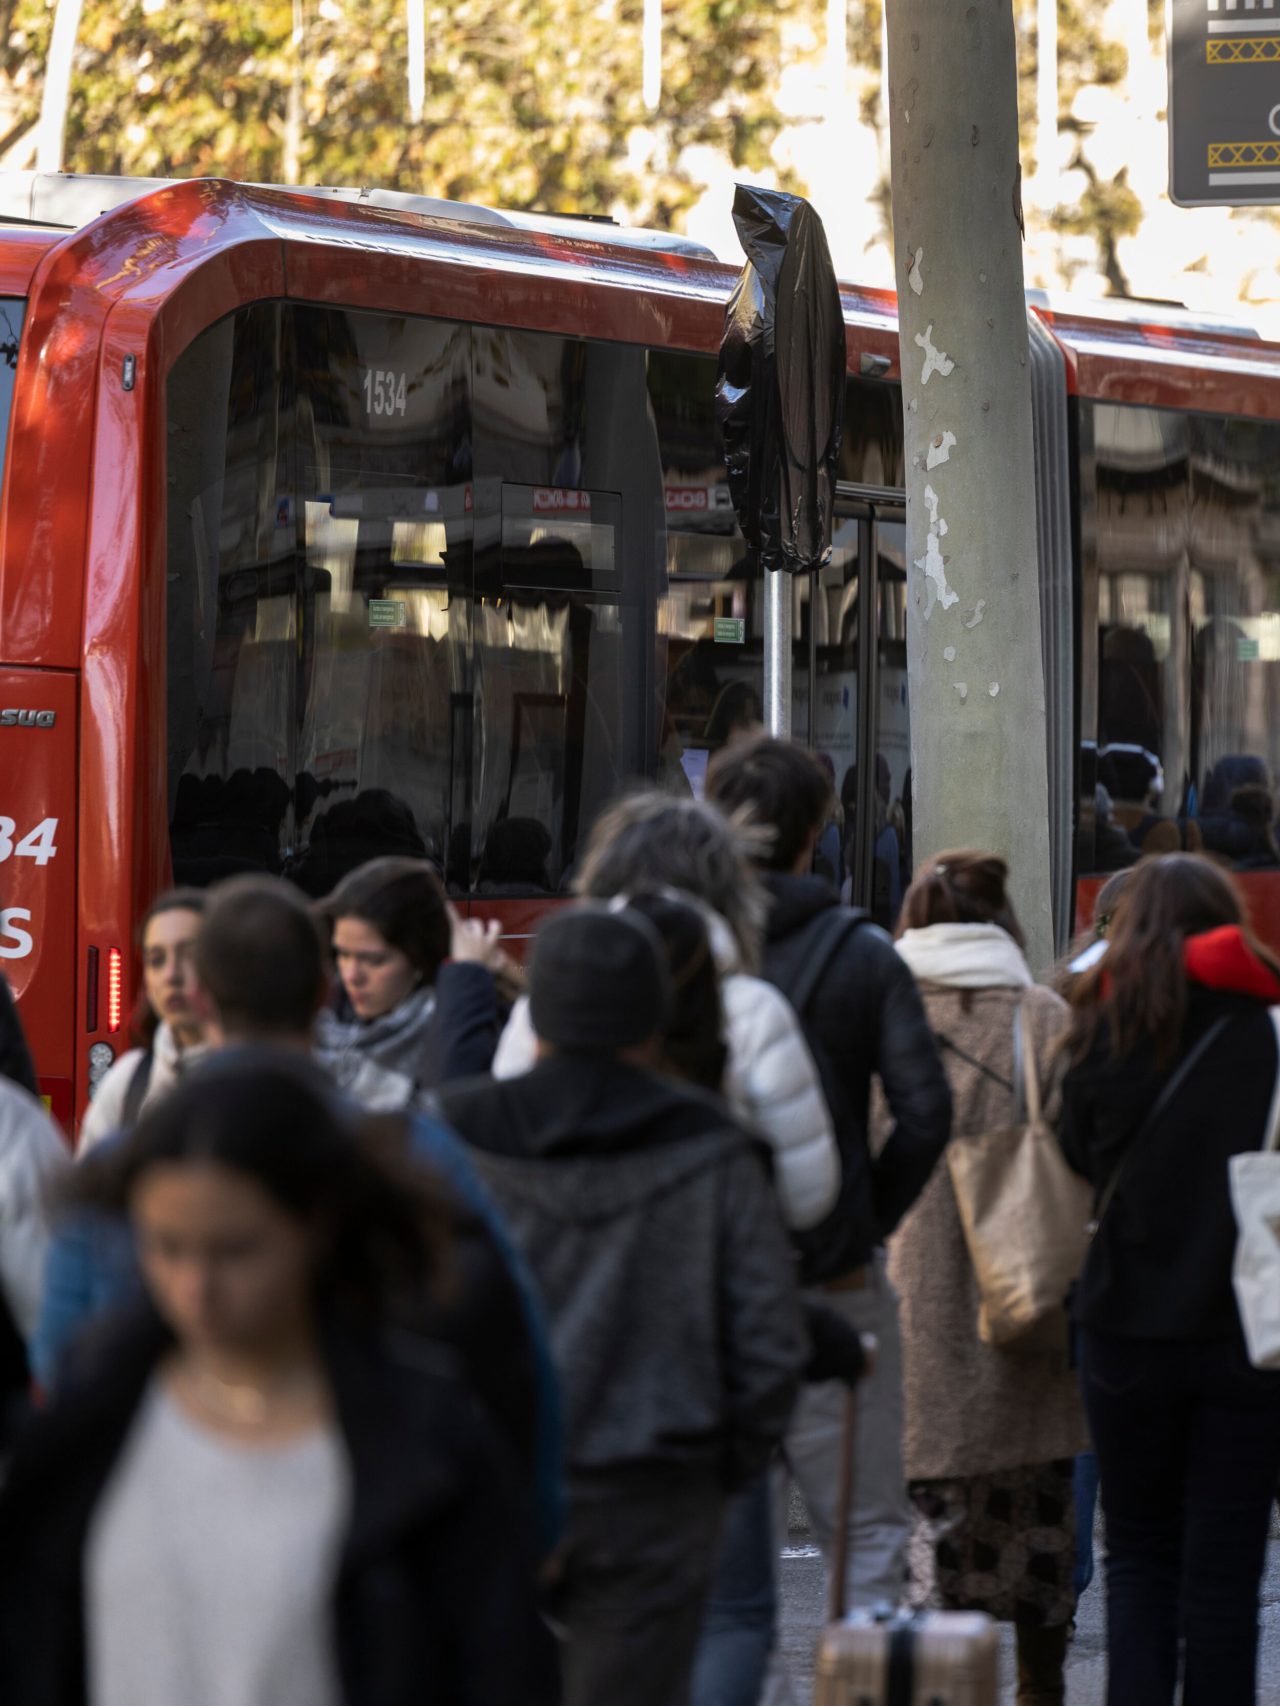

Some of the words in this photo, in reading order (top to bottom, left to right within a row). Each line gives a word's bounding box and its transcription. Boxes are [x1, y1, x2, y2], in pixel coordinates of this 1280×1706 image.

[363, 369, 407, 417] 1534
[0, 708, 56, 727] sua
[0, 907, 33, 959] S
